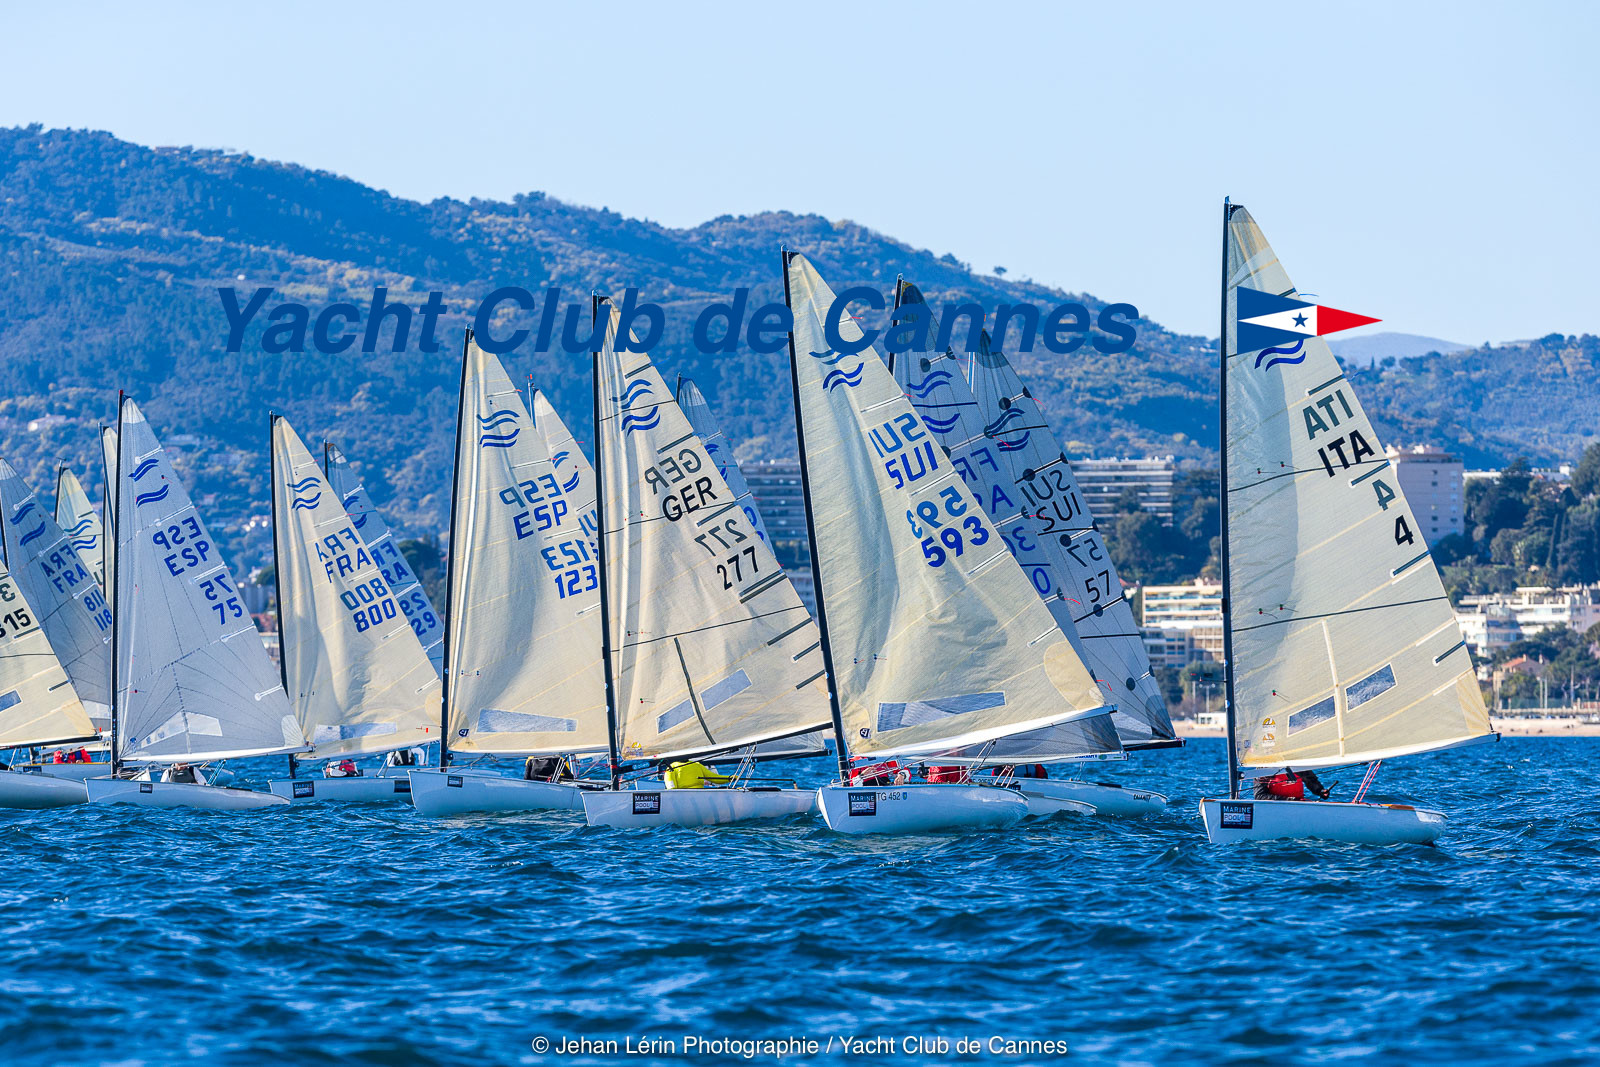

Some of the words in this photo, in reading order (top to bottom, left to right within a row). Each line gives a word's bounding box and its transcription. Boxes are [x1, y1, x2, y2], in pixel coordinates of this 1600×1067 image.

[885, 440, 938, 490] SUI
[1317, 429, 1375, 477] ITA
[662, 476, 718, 521] GER
[1036, 492, 1081, 531] SUI
[513, 500, 568, 540] ESP
[1394, 515, 1414, 546] 4
[164, 540, 210, 577] ESP
[921, 516, 990, 568] 593
[52, 563, 88, 593] FRA
[325, 547, 371, 583] FRA
[554, 564, 598, 599] 123
[717, 545, 759, 590] 277
[1084, 569, 1110, 603] 57
[94, 608, 112, 632] 118
[212, 596, 243, 625] 75
[353, 598, 397, 633] 800
[410, 611, 437, 637] 29
[877, 792, 887, 801] TG
[888, 792, 901, 800] 452
[1223, 805, 1252, 814] MARINE
